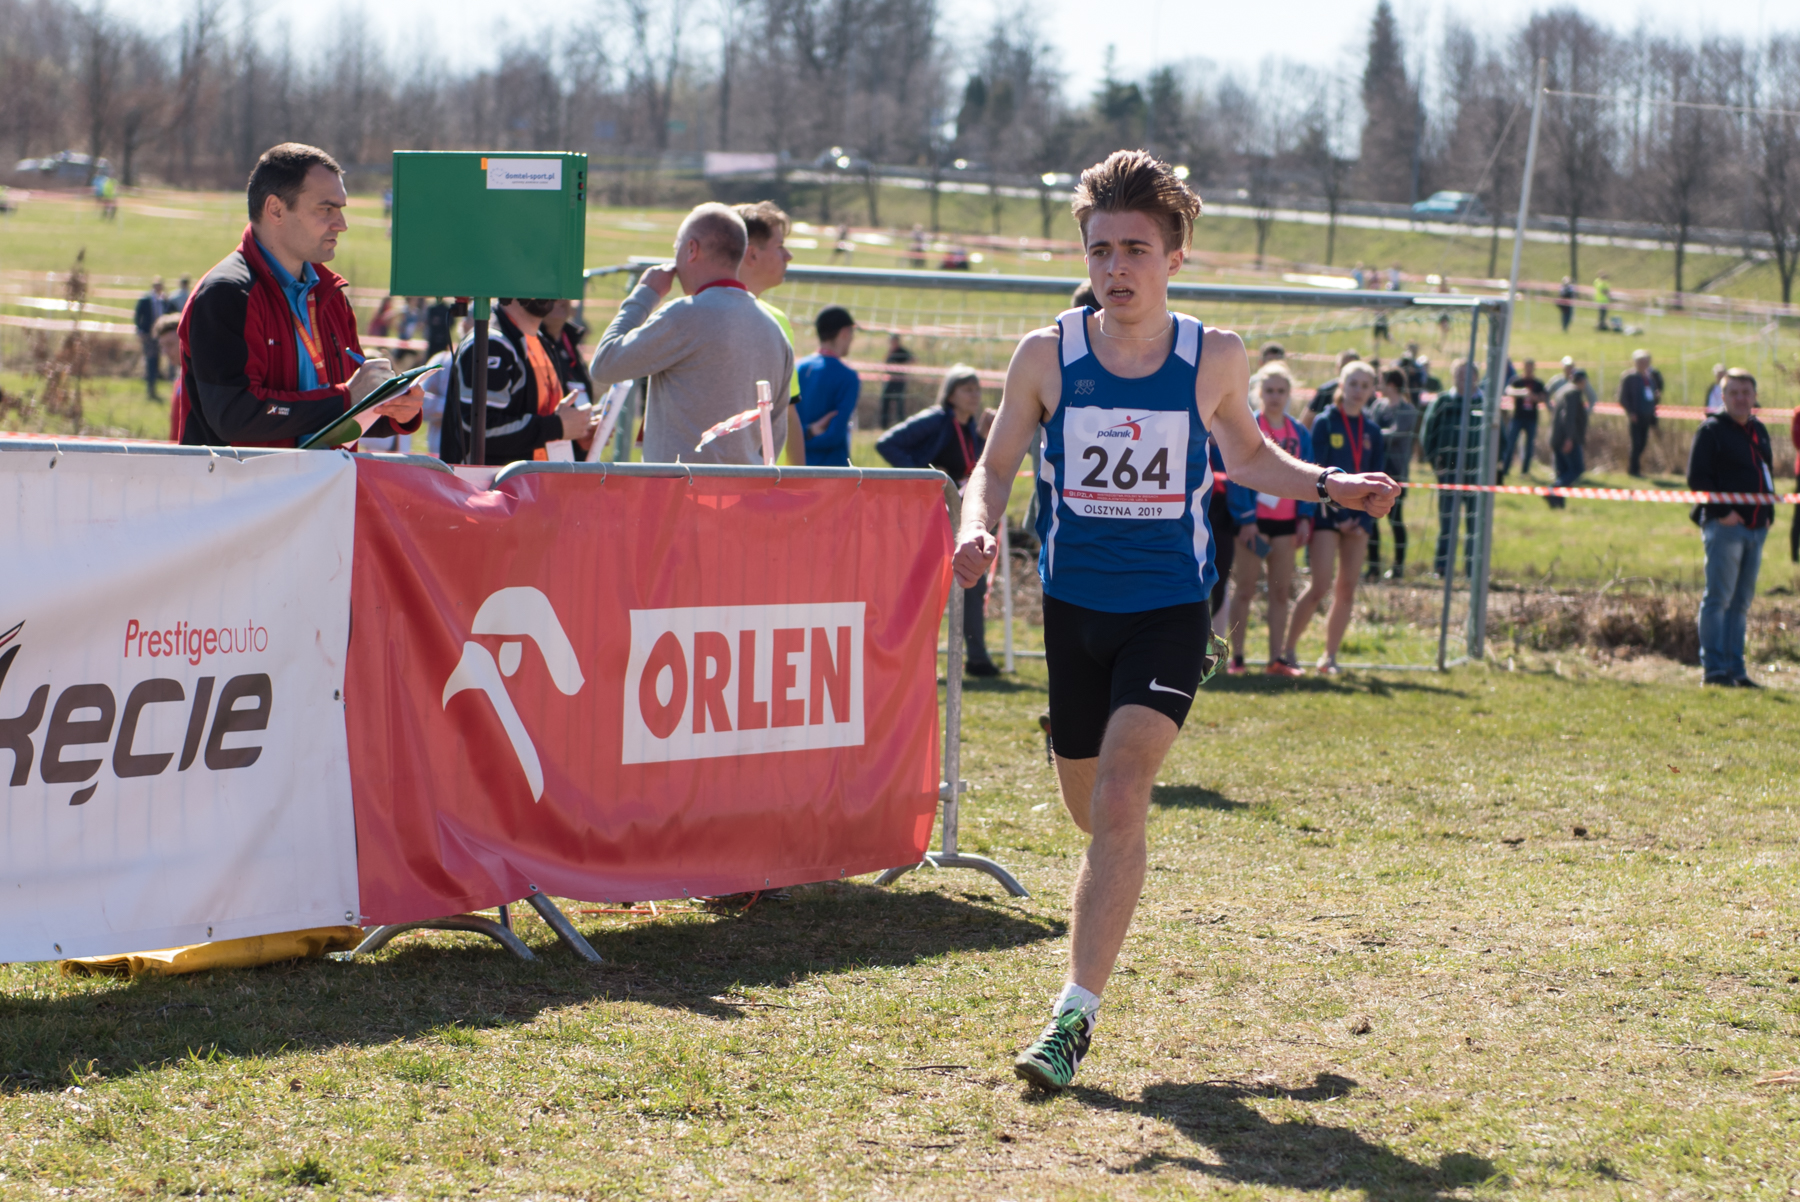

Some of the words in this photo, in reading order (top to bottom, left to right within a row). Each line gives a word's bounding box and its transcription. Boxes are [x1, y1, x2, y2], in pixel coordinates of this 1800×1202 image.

[1097, 429, 1131, 438] polanik
[1081, 445, 1170, 490] 264
[1084, 504, 1131, 516] OLSZYNA
[1138, 507, 1162, 516] 2019
[124, 619, 268, 666] Prestigeauto
[638, 625, 852, 740] ORLEN
